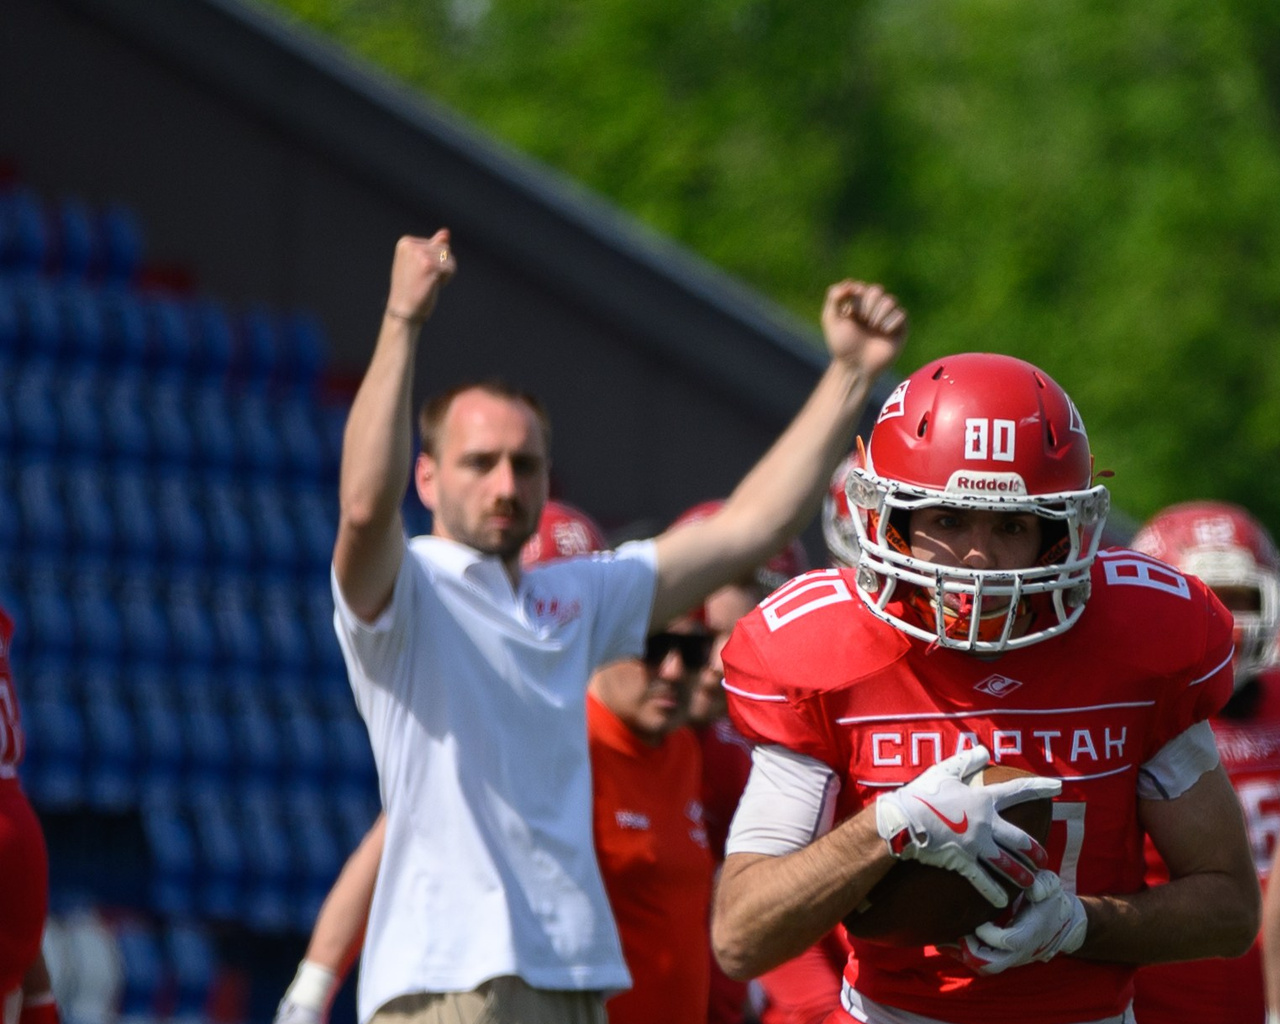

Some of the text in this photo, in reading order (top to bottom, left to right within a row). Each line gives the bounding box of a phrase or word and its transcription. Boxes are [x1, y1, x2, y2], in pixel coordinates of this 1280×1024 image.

[964, 417, 1016, 462] 80
[956, 476, 1021, 493] Riddell
[871, 726, 1128, 767] СПАРТАК
